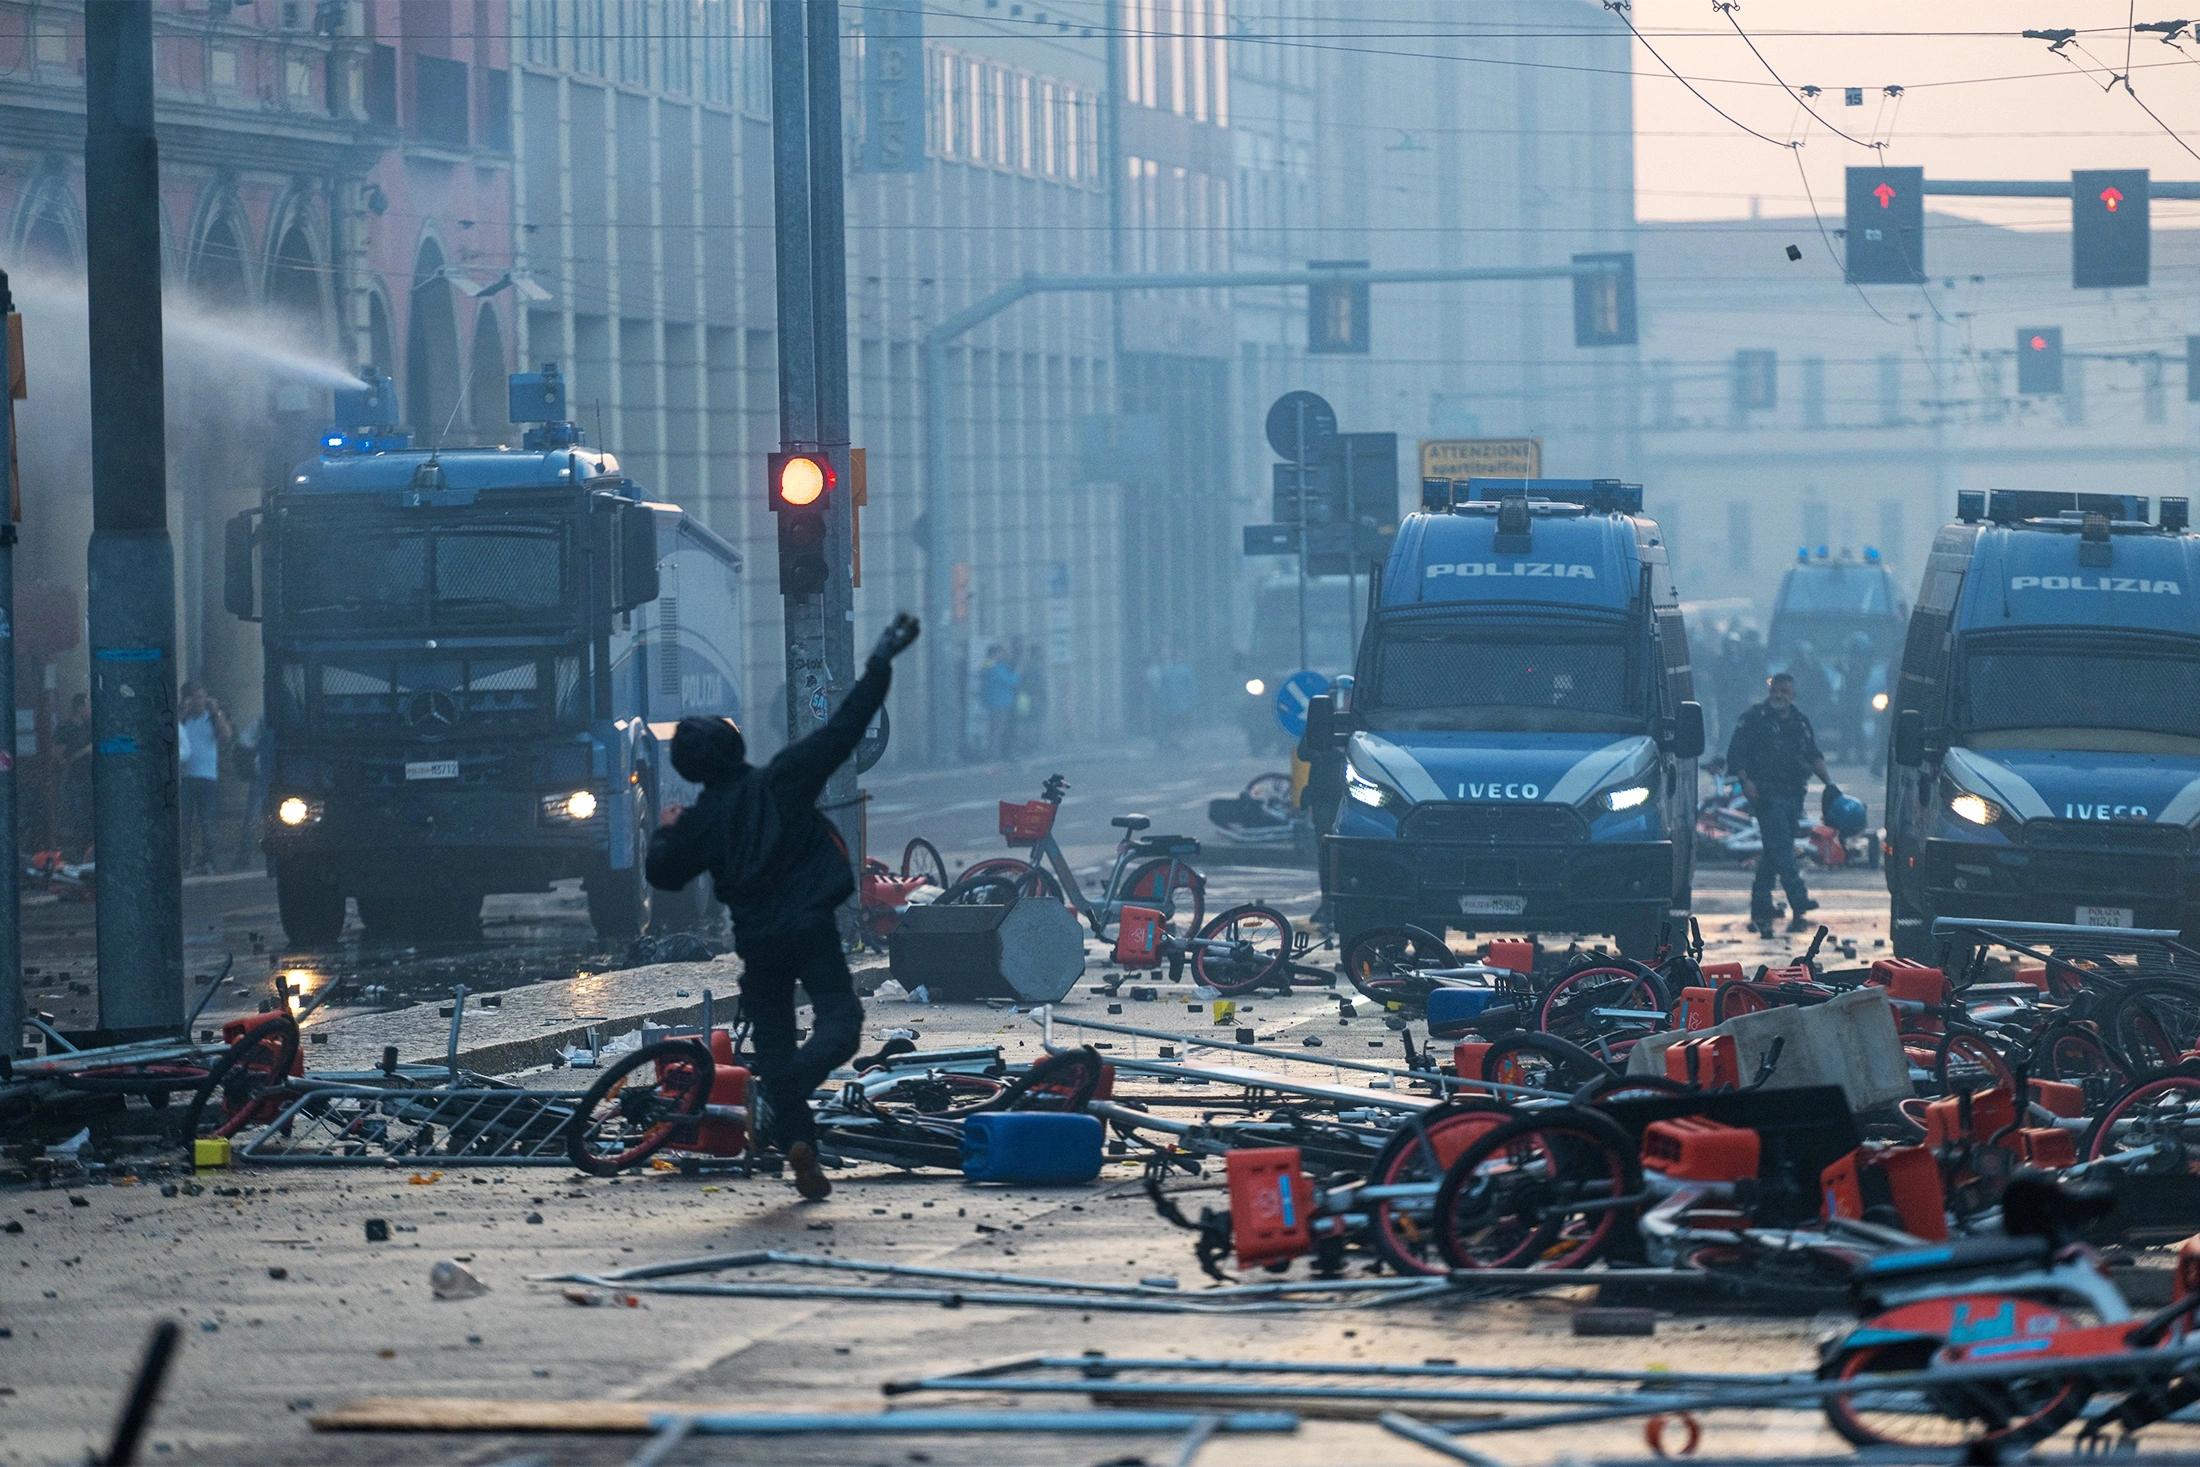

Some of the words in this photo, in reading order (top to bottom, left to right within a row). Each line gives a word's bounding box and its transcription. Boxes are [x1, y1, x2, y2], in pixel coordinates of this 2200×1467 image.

[1846, 94, 1862, 105] 15
[1430, 444, 1530, 458] ATTENZIONE
[413, 493, 420, 506] 2
[1426, 562, 1596, 579] POLIZIA
[2011, 576, 2182, 595] POLIZIA
[1458, 783, 1539, 799] IVECO
[2065, 803, 2148, 821] IVECO
